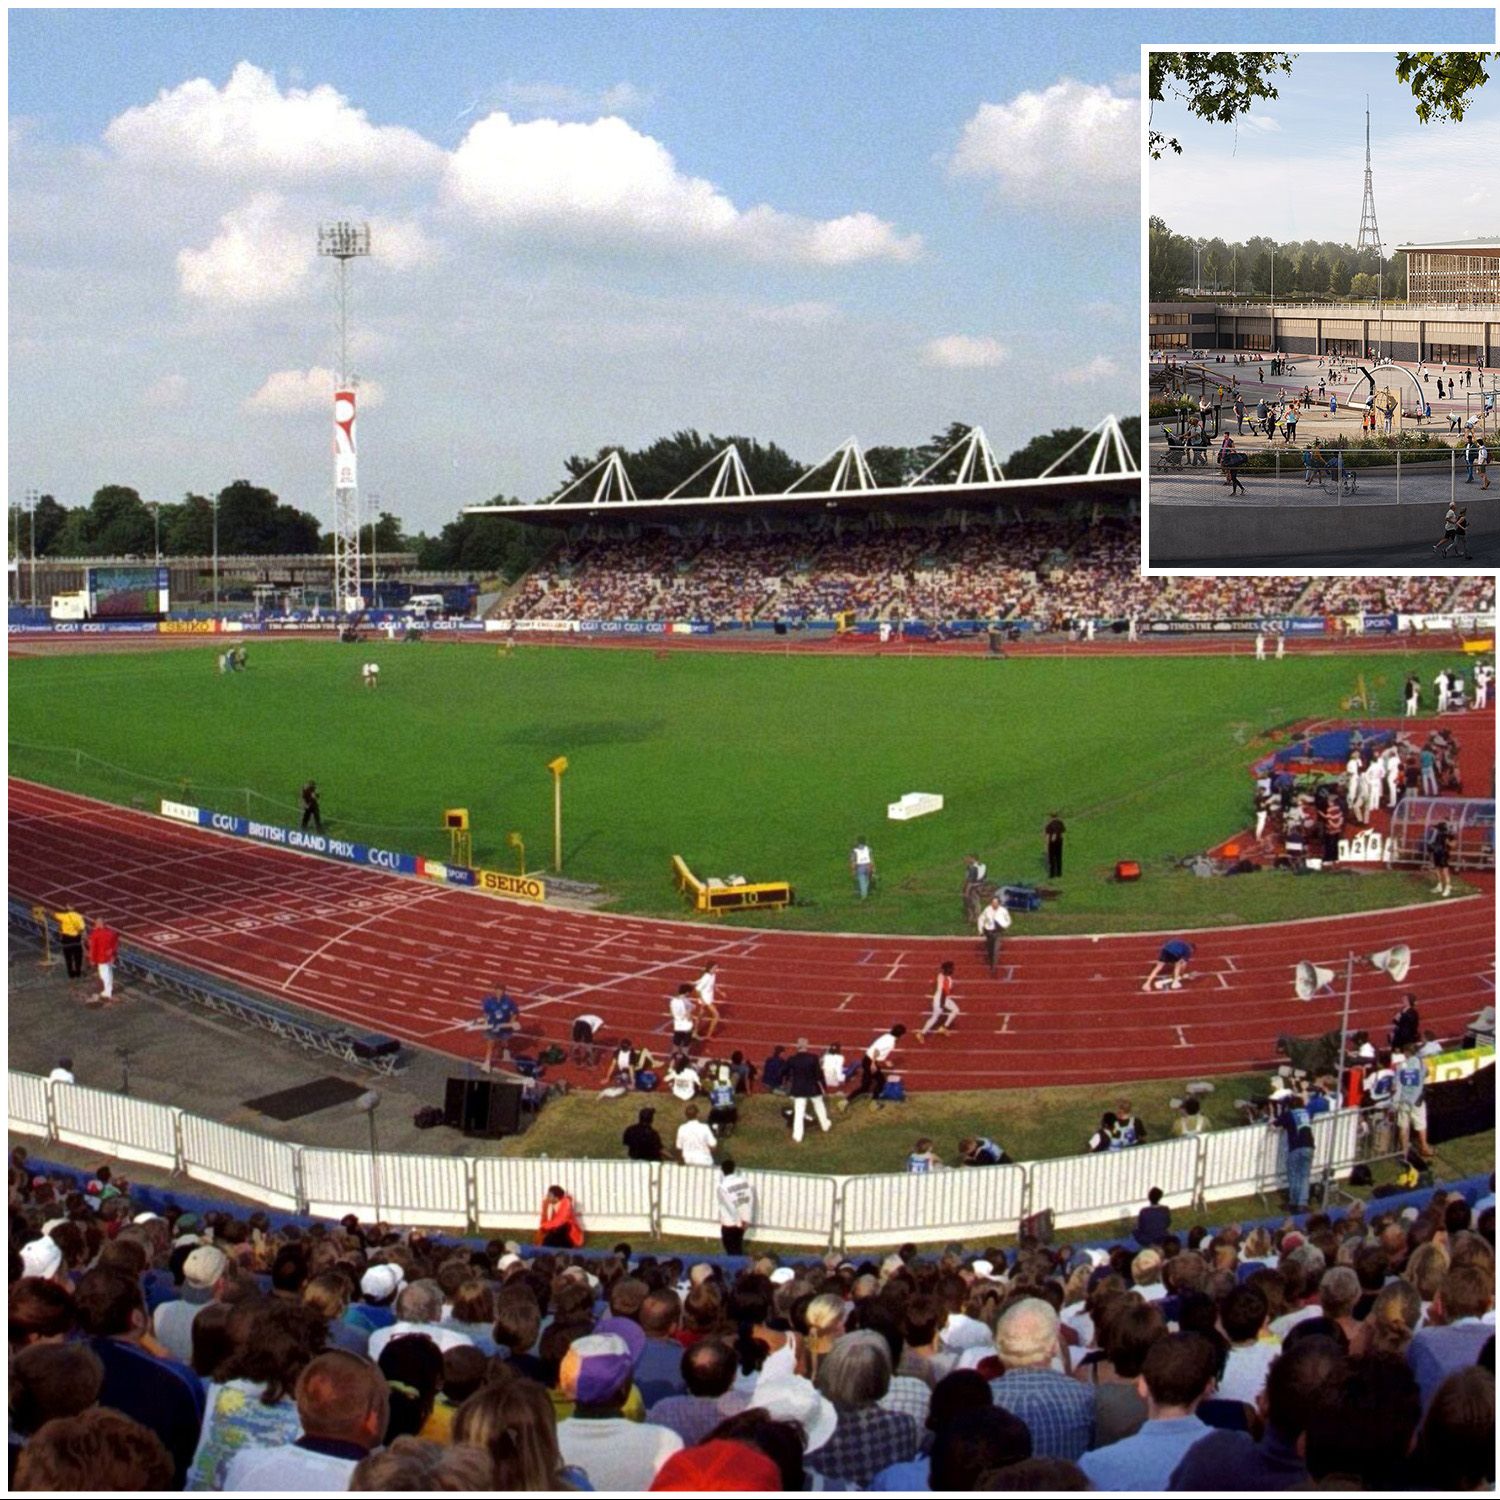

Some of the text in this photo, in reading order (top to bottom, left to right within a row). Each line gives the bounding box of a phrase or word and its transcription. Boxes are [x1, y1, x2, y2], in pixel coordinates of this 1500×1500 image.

[165, 622, 210, 632] SEIKO
[212, 813, 400, 868] CGU BRITISH GRAND PRIX CGU
[447, 869, 469, 881] SPORT
[484, 873, 540, 897] SEIKO
